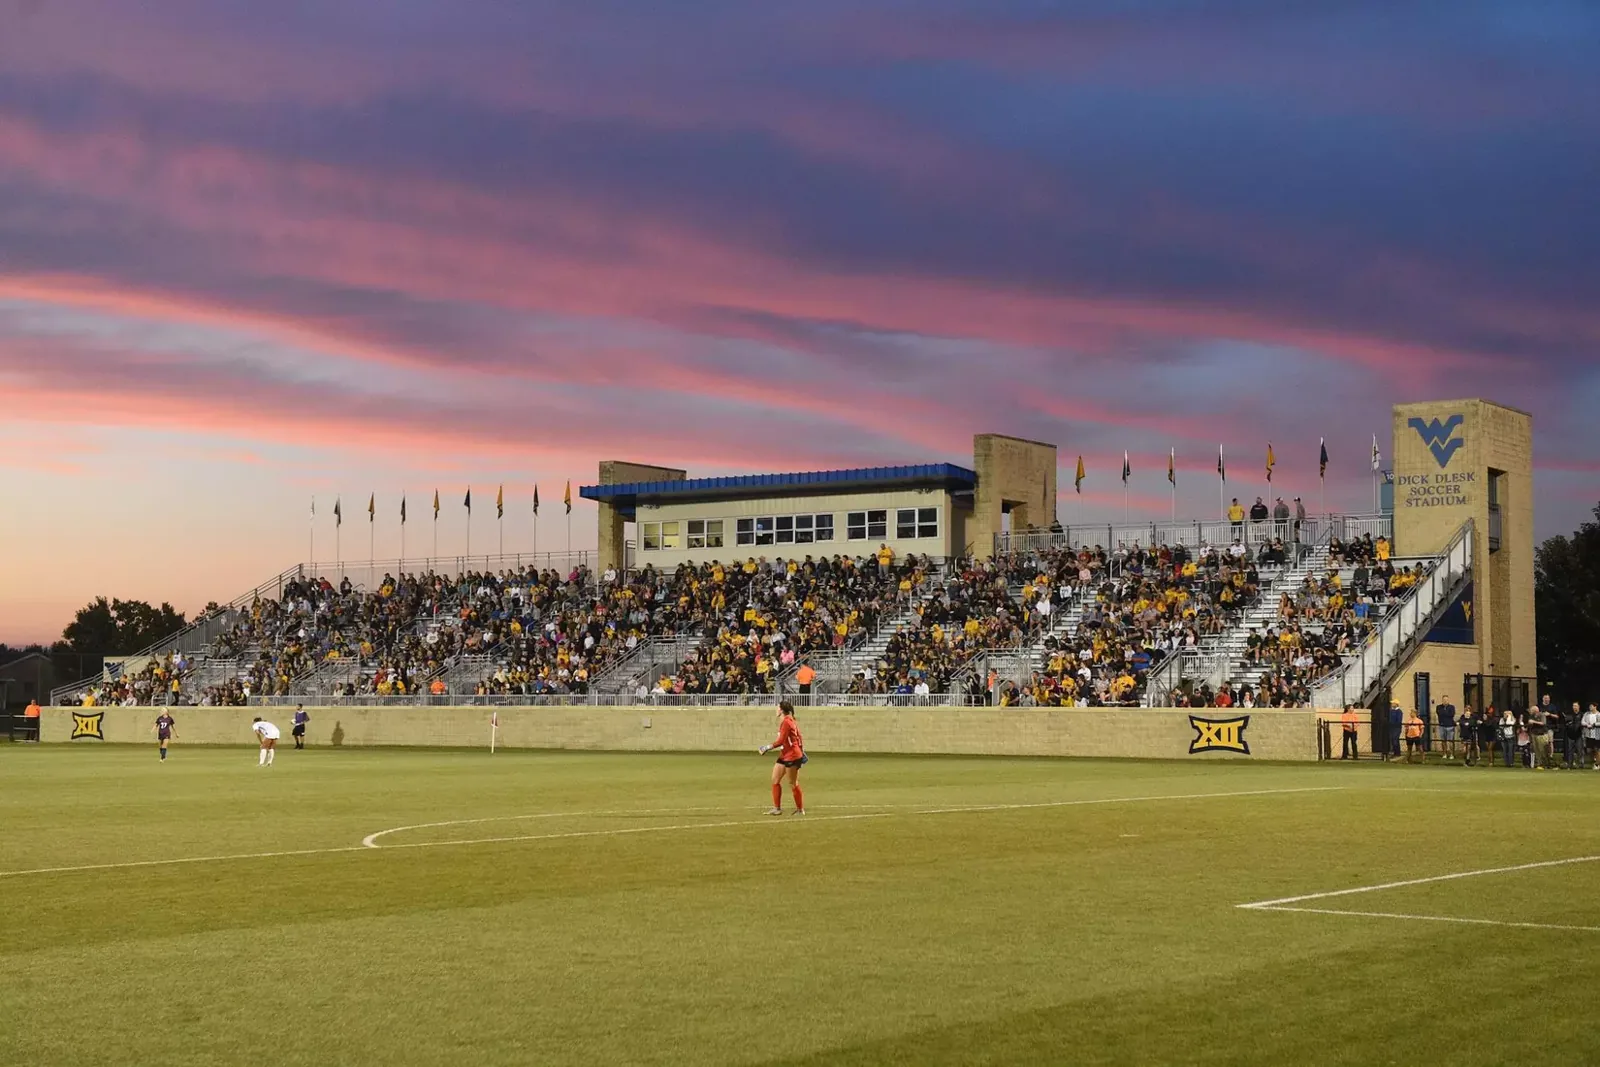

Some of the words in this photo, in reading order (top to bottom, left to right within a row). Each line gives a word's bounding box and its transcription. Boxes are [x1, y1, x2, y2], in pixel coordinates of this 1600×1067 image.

[1398, 474, 1429, 485] DICK
[1435, 472, 1475, 484] DLESK
[1410, 484, 1461, 496] SOCCER
[1406, 496, 1467, 507] STADIUM
[1191, 718, 1247, 752] XII
